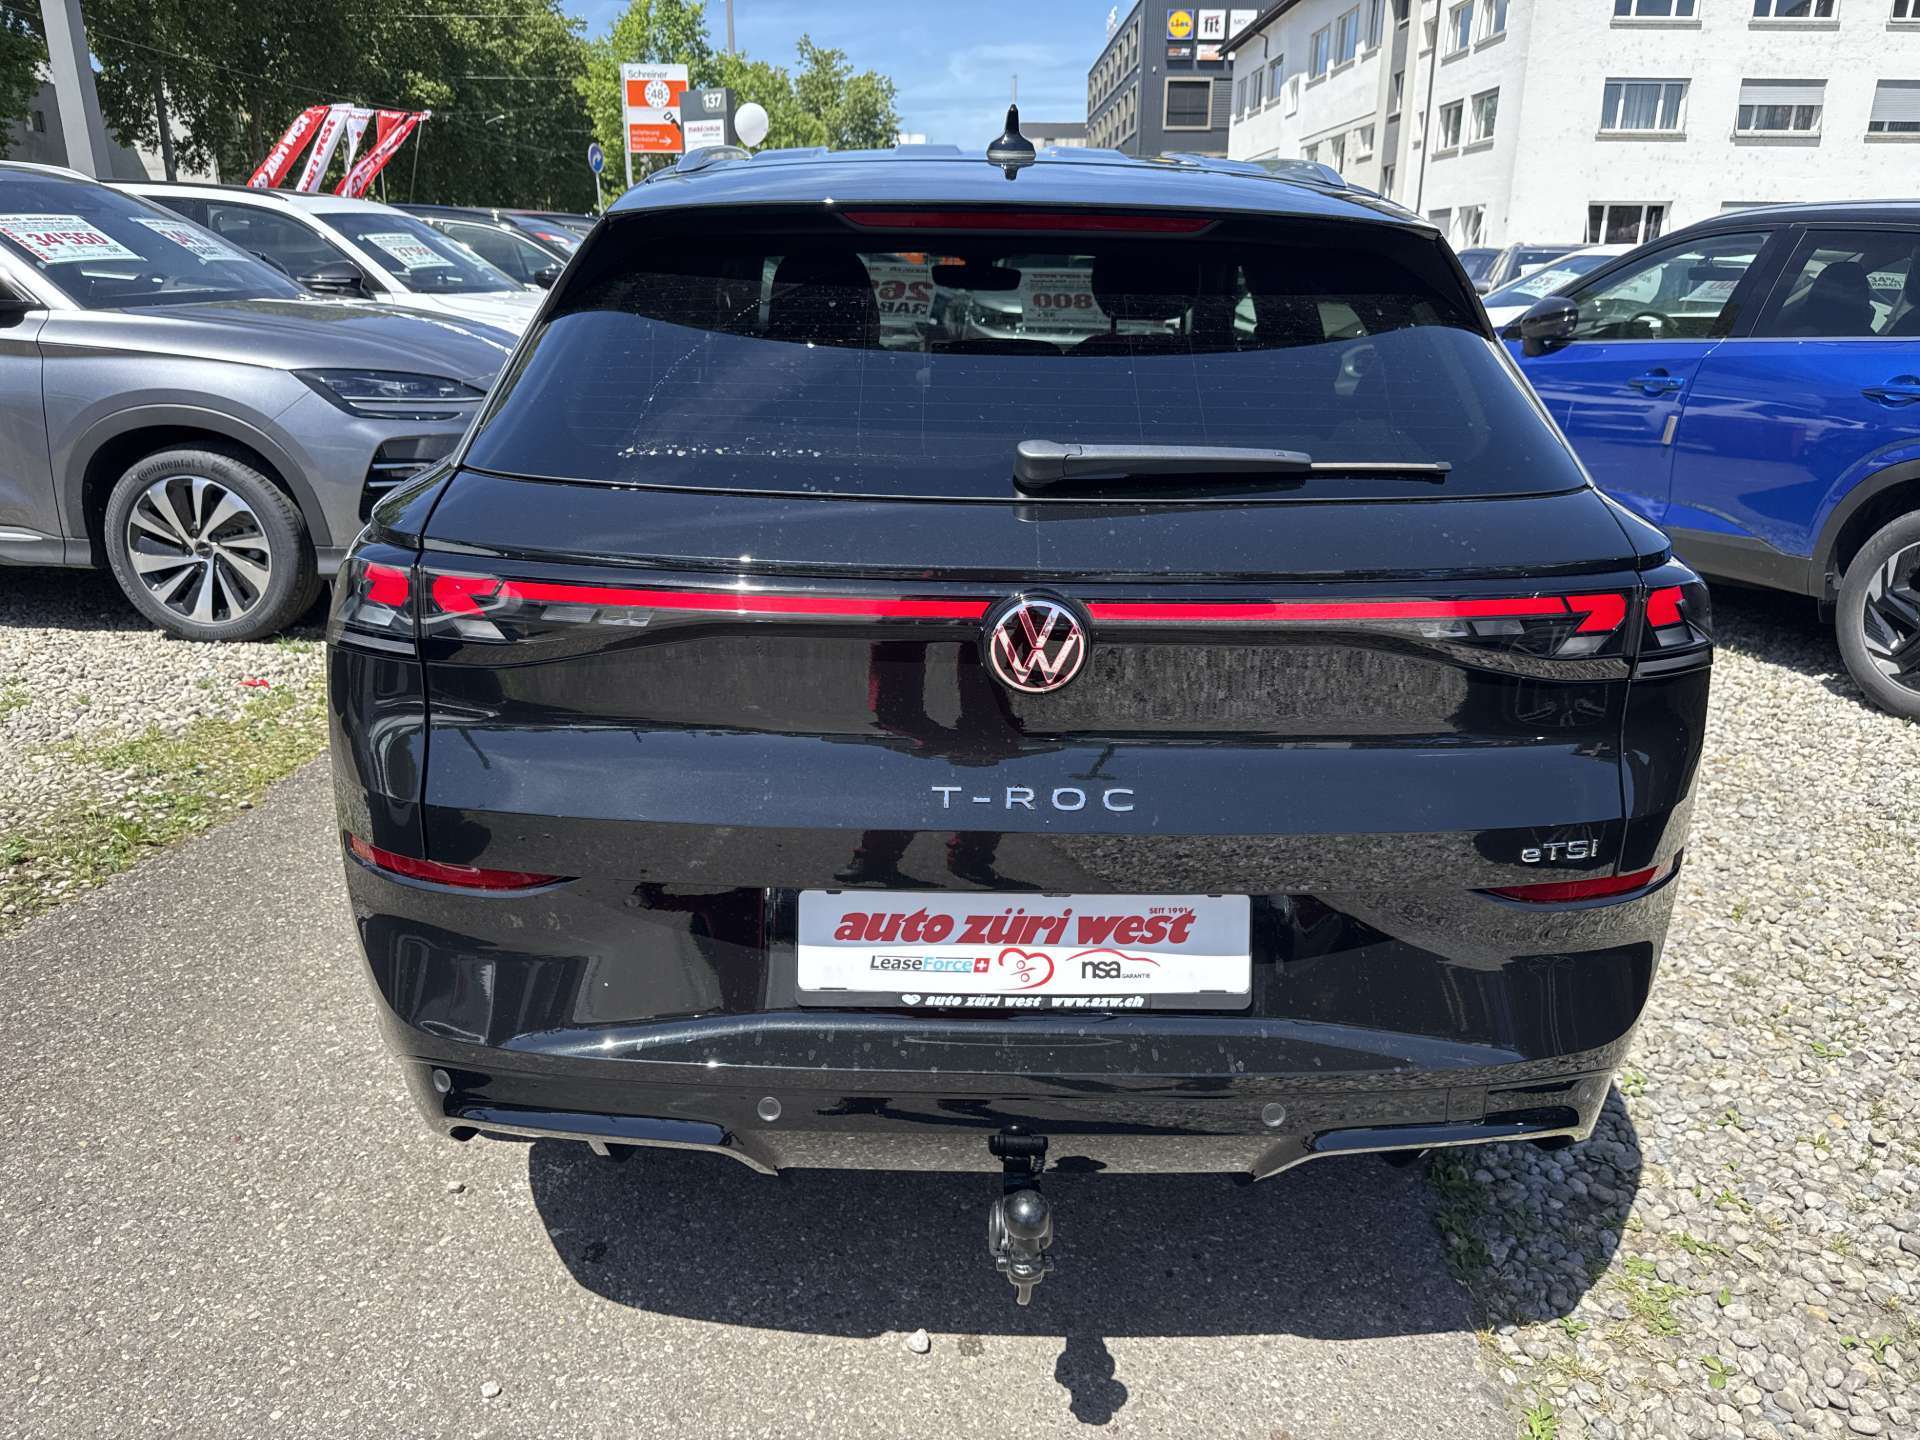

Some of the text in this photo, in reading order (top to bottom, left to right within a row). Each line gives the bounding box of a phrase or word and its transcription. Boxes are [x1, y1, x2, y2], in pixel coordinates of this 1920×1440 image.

[628, 69, 668, 79] Schreiner
[650, 89, 664, 99] 48
[703, 92, 722, 108] 137
[26, 232, 109, 247] 34'550
[931, 786, 1135, 812] T-ROC
[834, 907, 1198, 945] auto züri west
[870, 955, 973, 973] LeaseForce
[1081, 961, 1121, 979] nsa
[925, 994, 1145, 1008] auto züri west www.azw.ch
